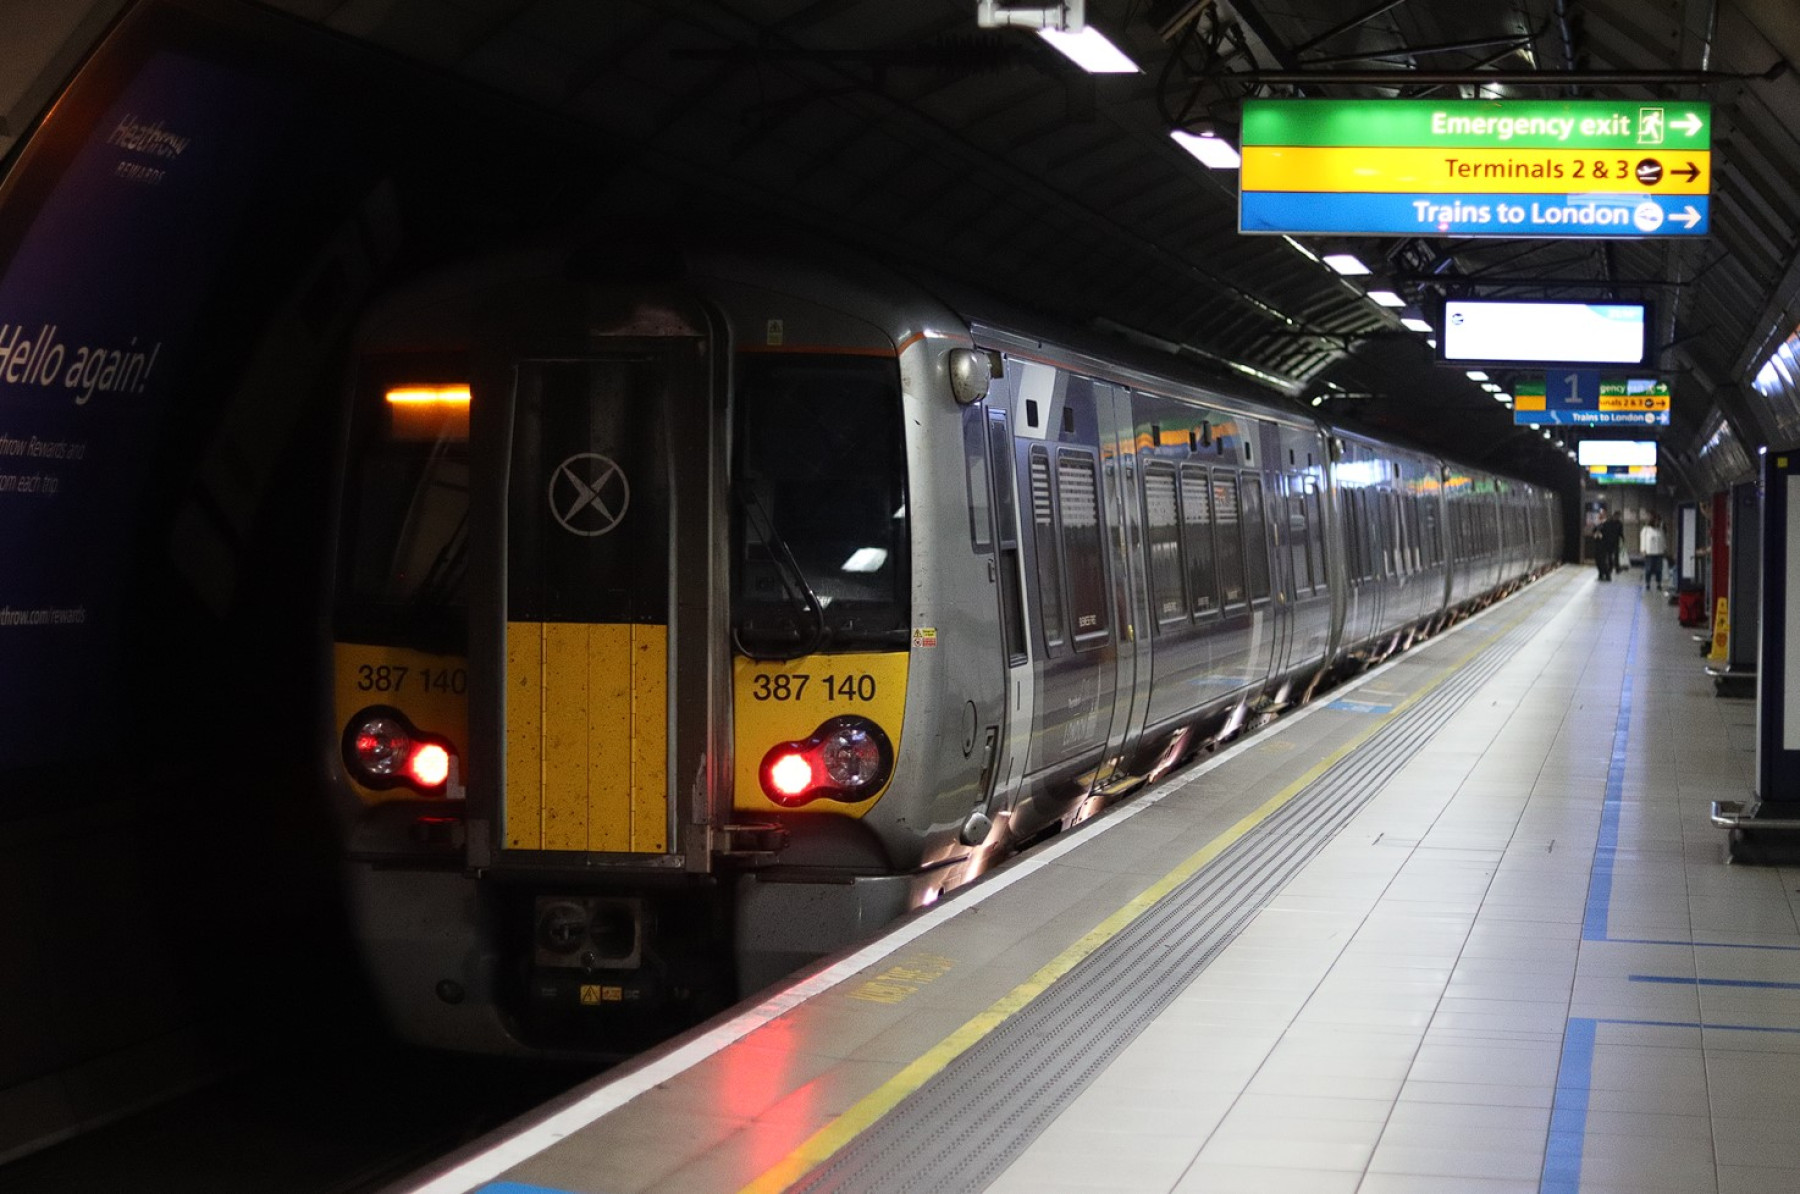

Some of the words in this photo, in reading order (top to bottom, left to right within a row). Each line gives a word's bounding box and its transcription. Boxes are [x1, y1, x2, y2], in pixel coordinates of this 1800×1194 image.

[106, 113, 192, 158] Heathrow
[1431, 112, 1574, 141] Emergency
[1580, 114, 1631, 136] exit
[1445, 159, 1564, 179] Terminals
[1572, 160, 1585, 179] 2
[1592, 160, 1609, 179] &
[1616, 160, 1629, 179] 3
[1413, 201, 1491, 224] Trains
[1497, 203, 1525, 225] to
[1531, 203, 1630, 225] London
[0, 324, 65, 387] Hello
[64, 336, 162, 406] again!
[1564, 374, 1583, 403] 1
[1600, 384, 1626, 395] gency
[1572, 412, 1599, 422] Trains
[1600, 412, 1610, 422] to
[1611, 412, 1645, 422] London
[0, 604, 86, 626] throw.com/rewards
[358, 665, 408, 691] 387
[419, 668, 466, 694] 140
[753, 673, 810, 701] 387
[822, 674, 876, 701] 140
